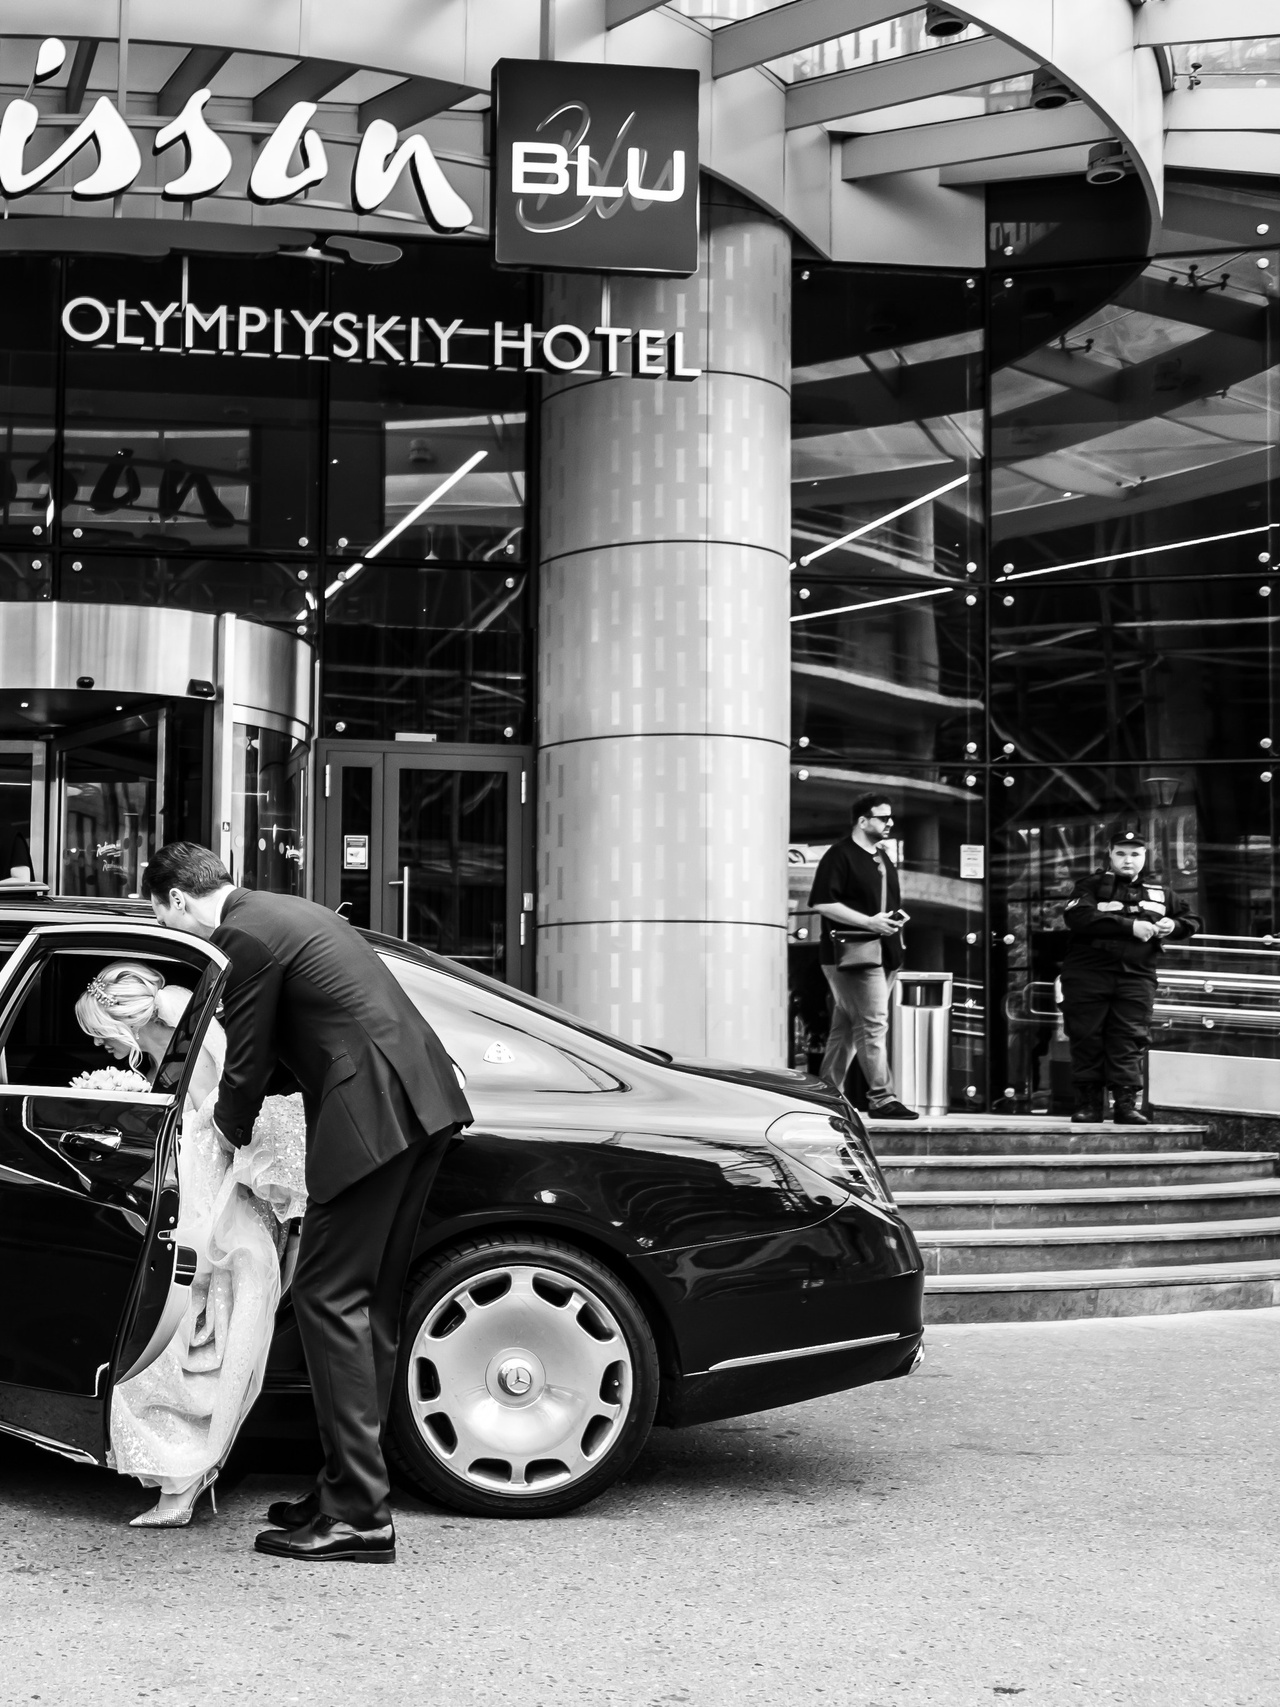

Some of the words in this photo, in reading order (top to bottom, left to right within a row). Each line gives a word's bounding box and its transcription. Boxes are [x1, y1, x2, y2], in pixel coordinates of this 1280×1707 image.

[511, 141, 686, 203] BLU
[61, 296, 465, 364] OLYMPIYSKIY
[493, 320, 702, 379] HOTEL
